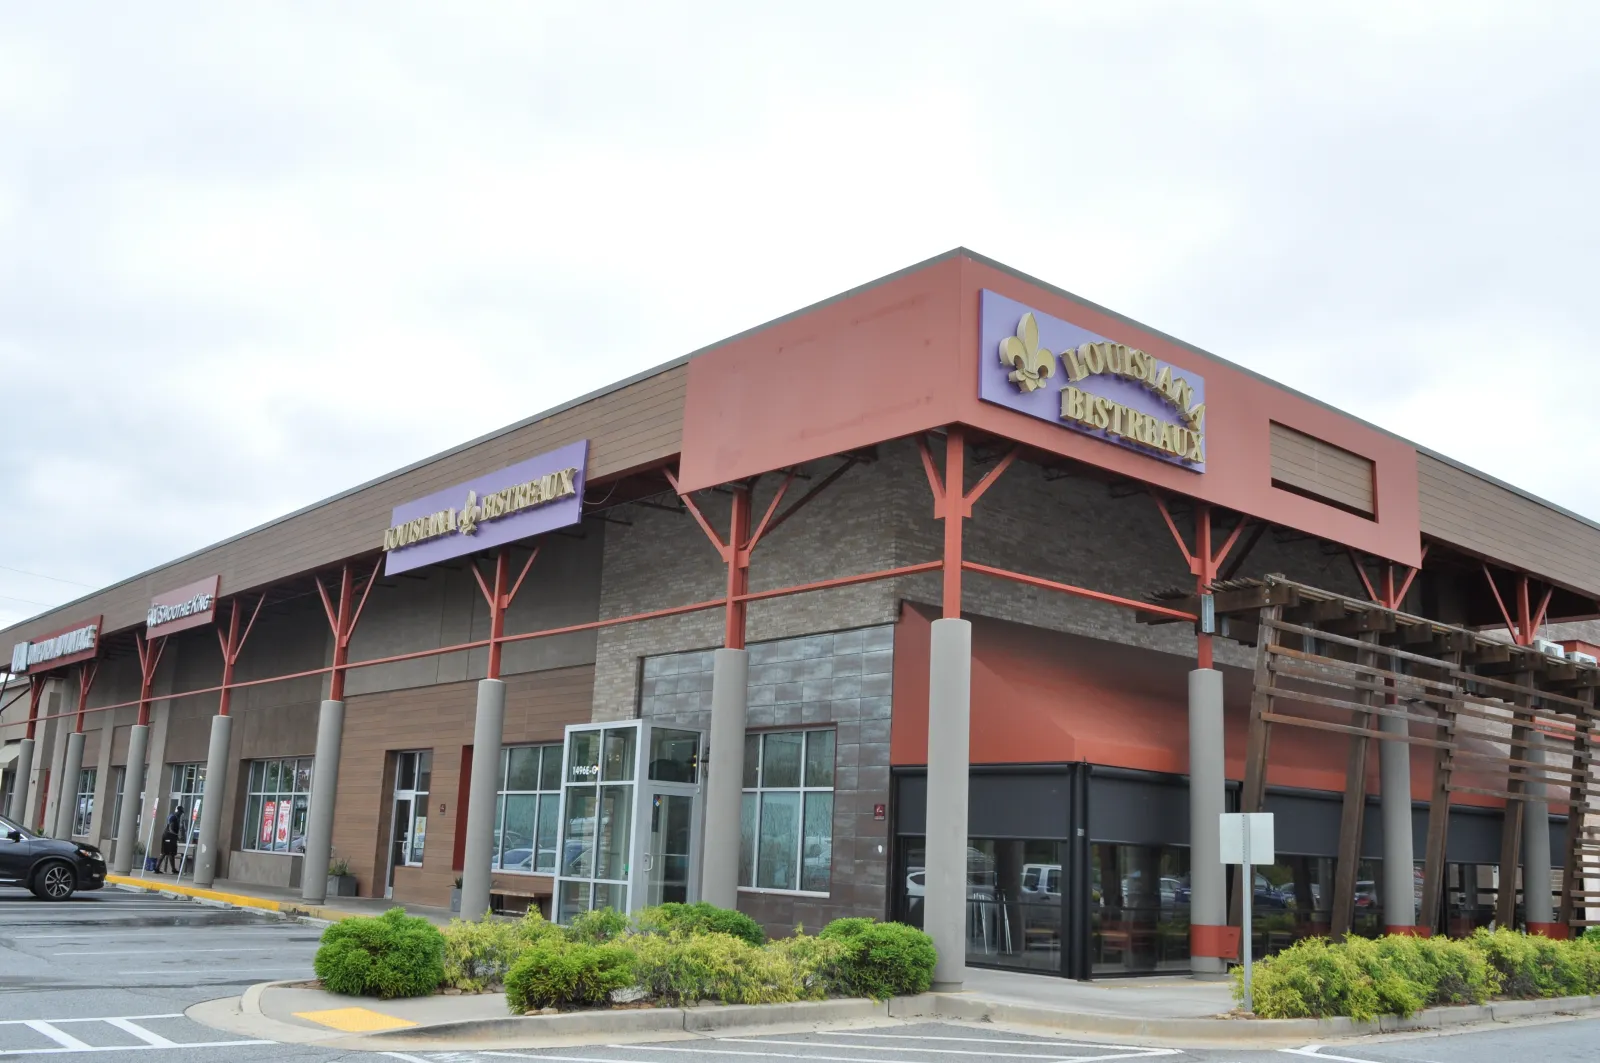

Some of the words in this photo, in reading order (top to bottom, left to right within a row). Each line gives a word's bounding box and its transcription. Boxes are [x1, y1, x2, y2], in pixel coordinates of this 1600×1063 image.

[1059, 386, 1204, 463] BISTREAUX
[1060, 341, 1205, 432] LOUISIANA
[382, 507, 457, 551] LOUISIANA
[480, 467, 578, 521] BISTREAUX
